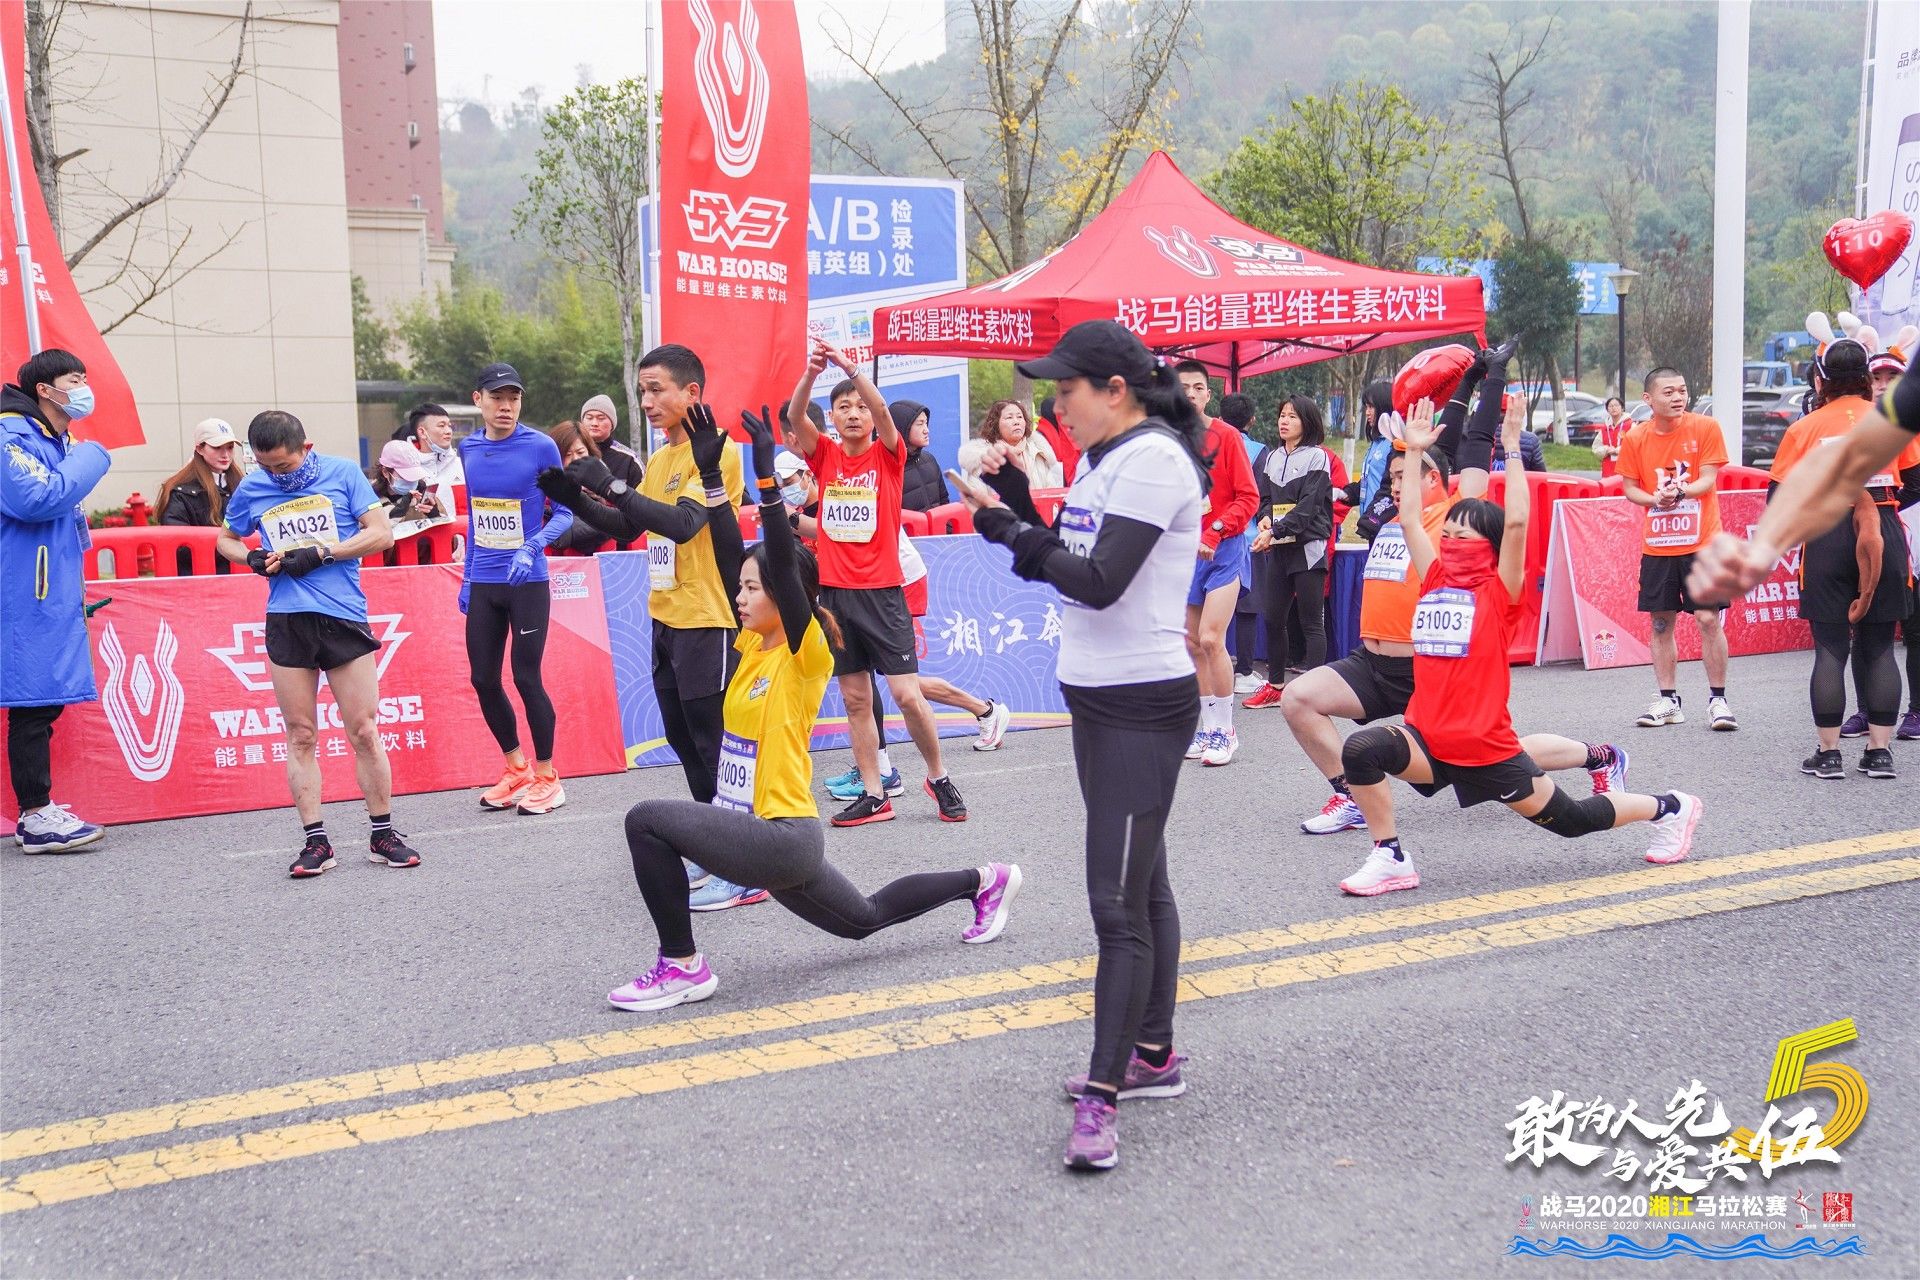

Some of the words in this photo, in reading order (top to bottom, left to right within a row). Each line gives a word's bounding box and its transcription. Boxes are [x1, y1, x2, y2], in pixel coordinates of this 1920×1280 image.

[890, 198, 915, 277] 检录处
[1831, 229, 1884, 257] 1:10
[676, 249, 718, 276] WAR
[719, 256, 788, 285] HORSE
[676, 276, 788, 305] 能量型维生素饮料
[1114, 284, 1447, 336] 战马能量型维生素饮料
[887, 306, 1034, 348] 战马能量型维生素饮料
[889, 357, 929, 370] MARATHON
[278, 513, 330, 540] A1032
[477, 514, 517, 531] A1005
[827, 504, 870, 522] A1029
[1651, 514, 1692, 533] 01:00
[1371, 542, 1407, 561] C1422
[1416, 610, 1463, 631] B1003
[316, 695, 425, 731] OSE
[214, 729, 428, 769] 能量型生饮料
[718, 758, 747, 788] 1009
